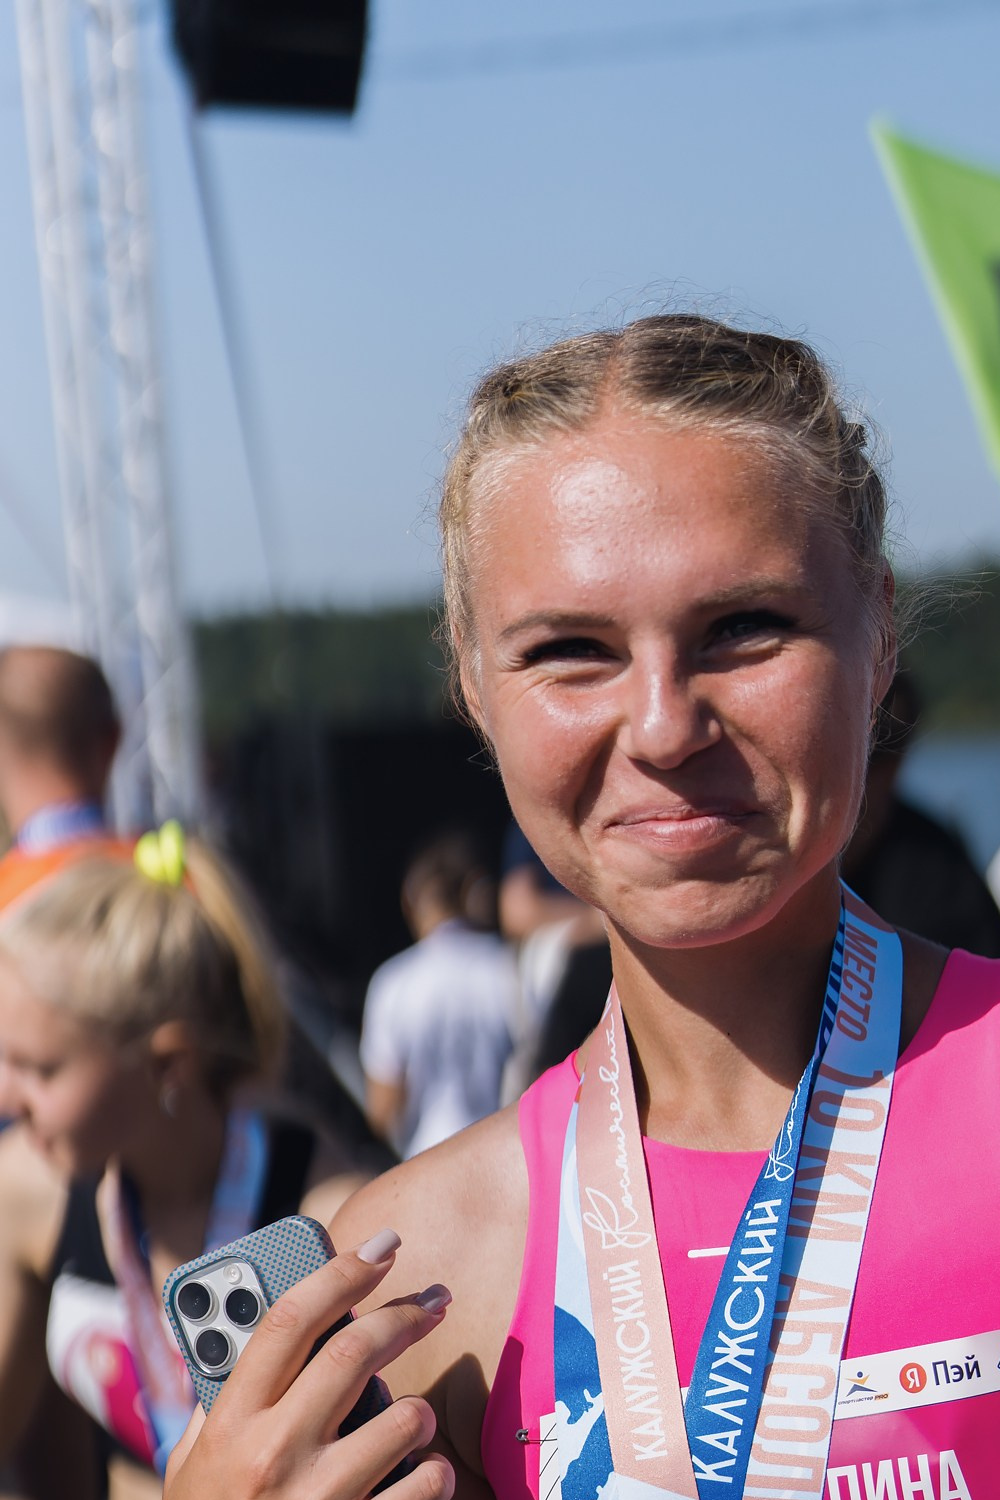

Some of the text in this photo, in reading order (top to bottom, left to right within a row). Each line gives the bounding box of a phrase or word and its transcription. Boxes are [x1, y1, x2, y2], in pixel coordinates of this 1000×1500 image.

[836, 921, 878, 1042] МЕСТО
[602, 1259, 669, 1462] КАЛУЖСКИЙ
[694, 1198, 782, 1484] КАЛУЖСКИЙ
[931, 1354, 982, 1386] Пэй
